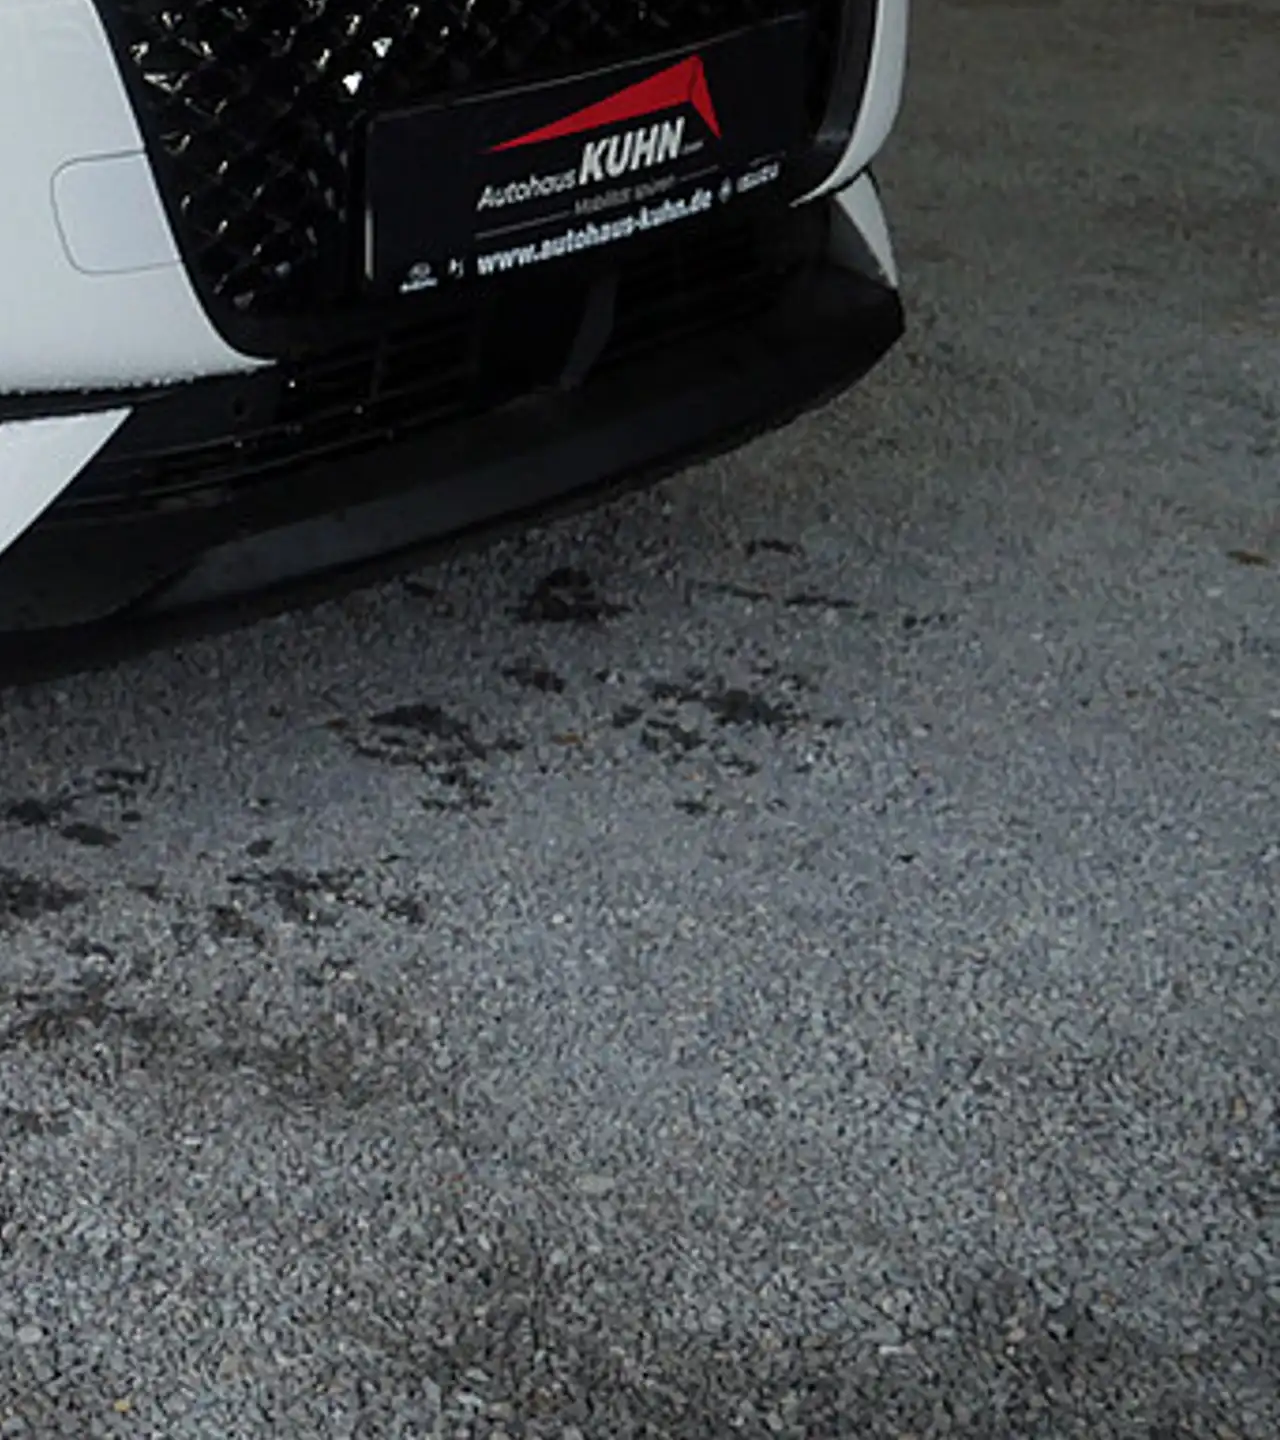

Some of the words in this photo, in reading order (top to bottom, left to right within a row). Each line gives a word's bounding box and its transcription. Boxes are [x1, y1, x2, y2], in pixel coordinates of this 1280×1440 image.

[475, 168, 577, 212] Autohaus
[578, 116, 687, 186] KUHN
[476, 186, 713, 277] www.autohaus-kuhn.de
